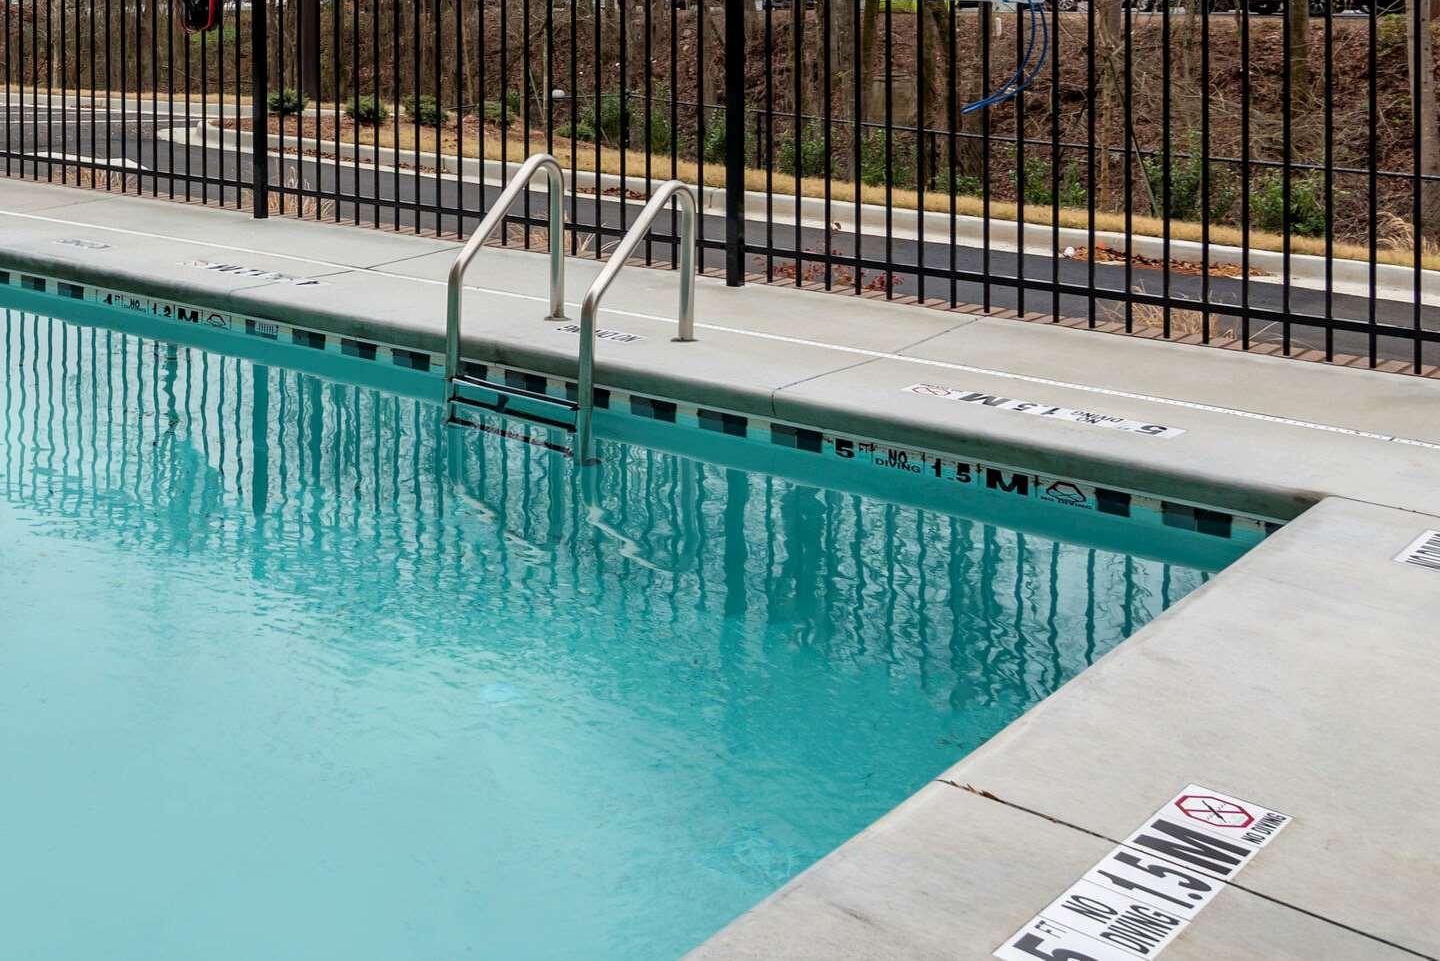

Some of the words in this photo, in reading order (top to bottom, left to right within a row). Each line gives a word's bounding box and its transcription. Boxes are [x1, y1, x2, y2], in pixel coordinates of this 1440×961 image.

[888, 448, 908, 463] NO
[875, 457, 921, 474] DIVING
[1250, 812, 1287, 835] DIVING
[1240, 832, 1266, 845] NO
[1061, 894, 1119, 924] NO
[1034, 920, 1068, 939] FT
[1099, 904, 1181, 955] DIVING
